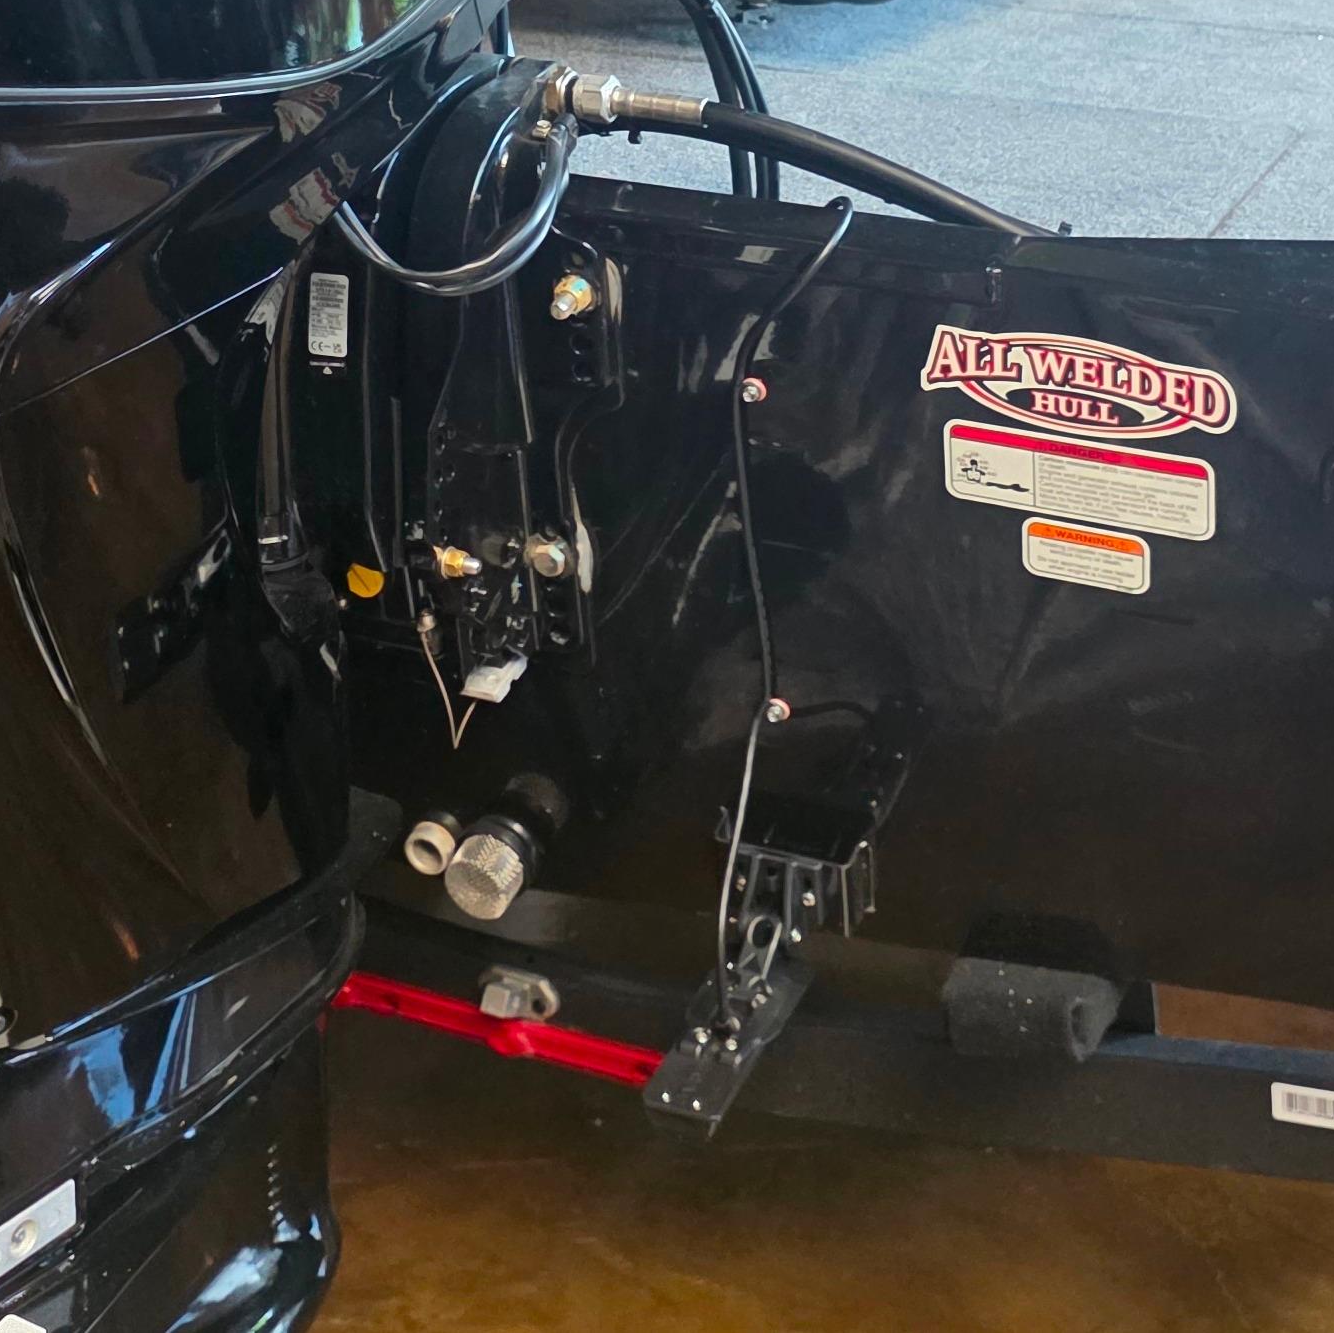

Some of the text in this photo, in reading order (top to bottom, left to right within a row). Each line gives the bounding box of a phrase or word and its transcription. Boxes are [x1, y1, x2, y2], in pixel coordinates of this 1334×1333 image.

[928, 331, 1229, 426] ALL WELDED
[1031, 390, 1120, 426] HULL
[1048, 443, 1105, 462] DANGER
[1055, 529, 1115, 548] WARNING
